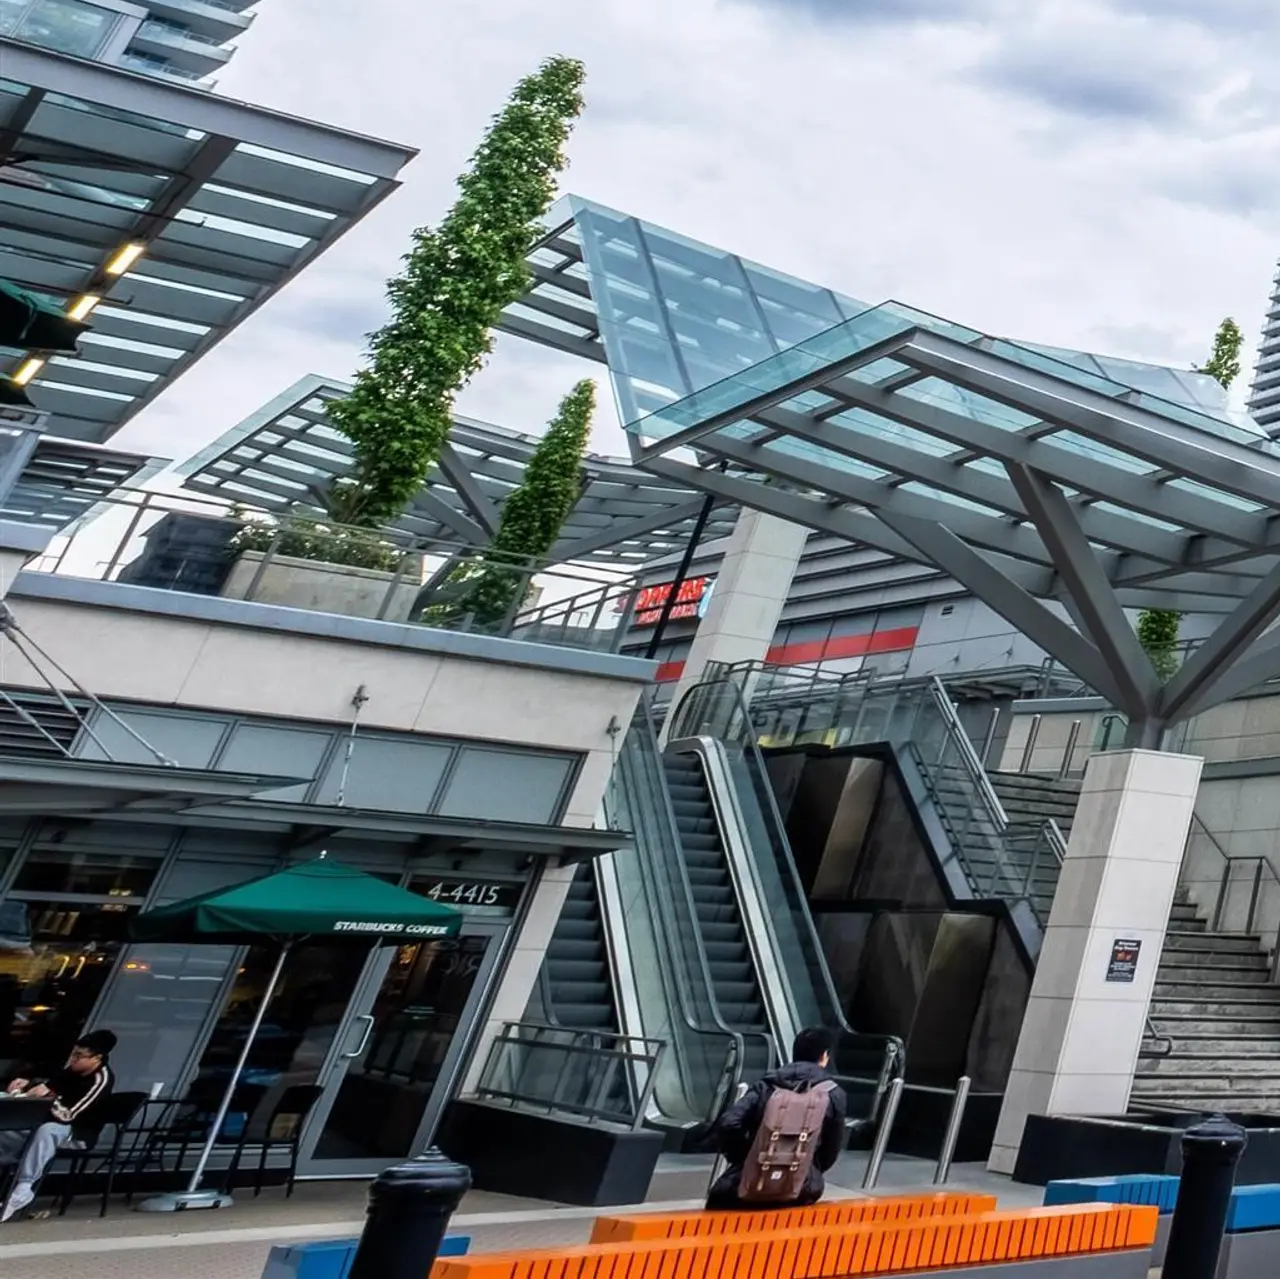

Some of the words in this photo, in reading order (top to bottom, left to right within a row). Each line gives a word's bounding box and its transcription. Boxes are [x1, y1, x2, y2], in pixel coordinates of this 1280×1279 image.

[427, 882, 500, 904] 4-4415
[333, 921, 403, 932] STARBUCKS
[405, 924, 449, 934] COFFEE
